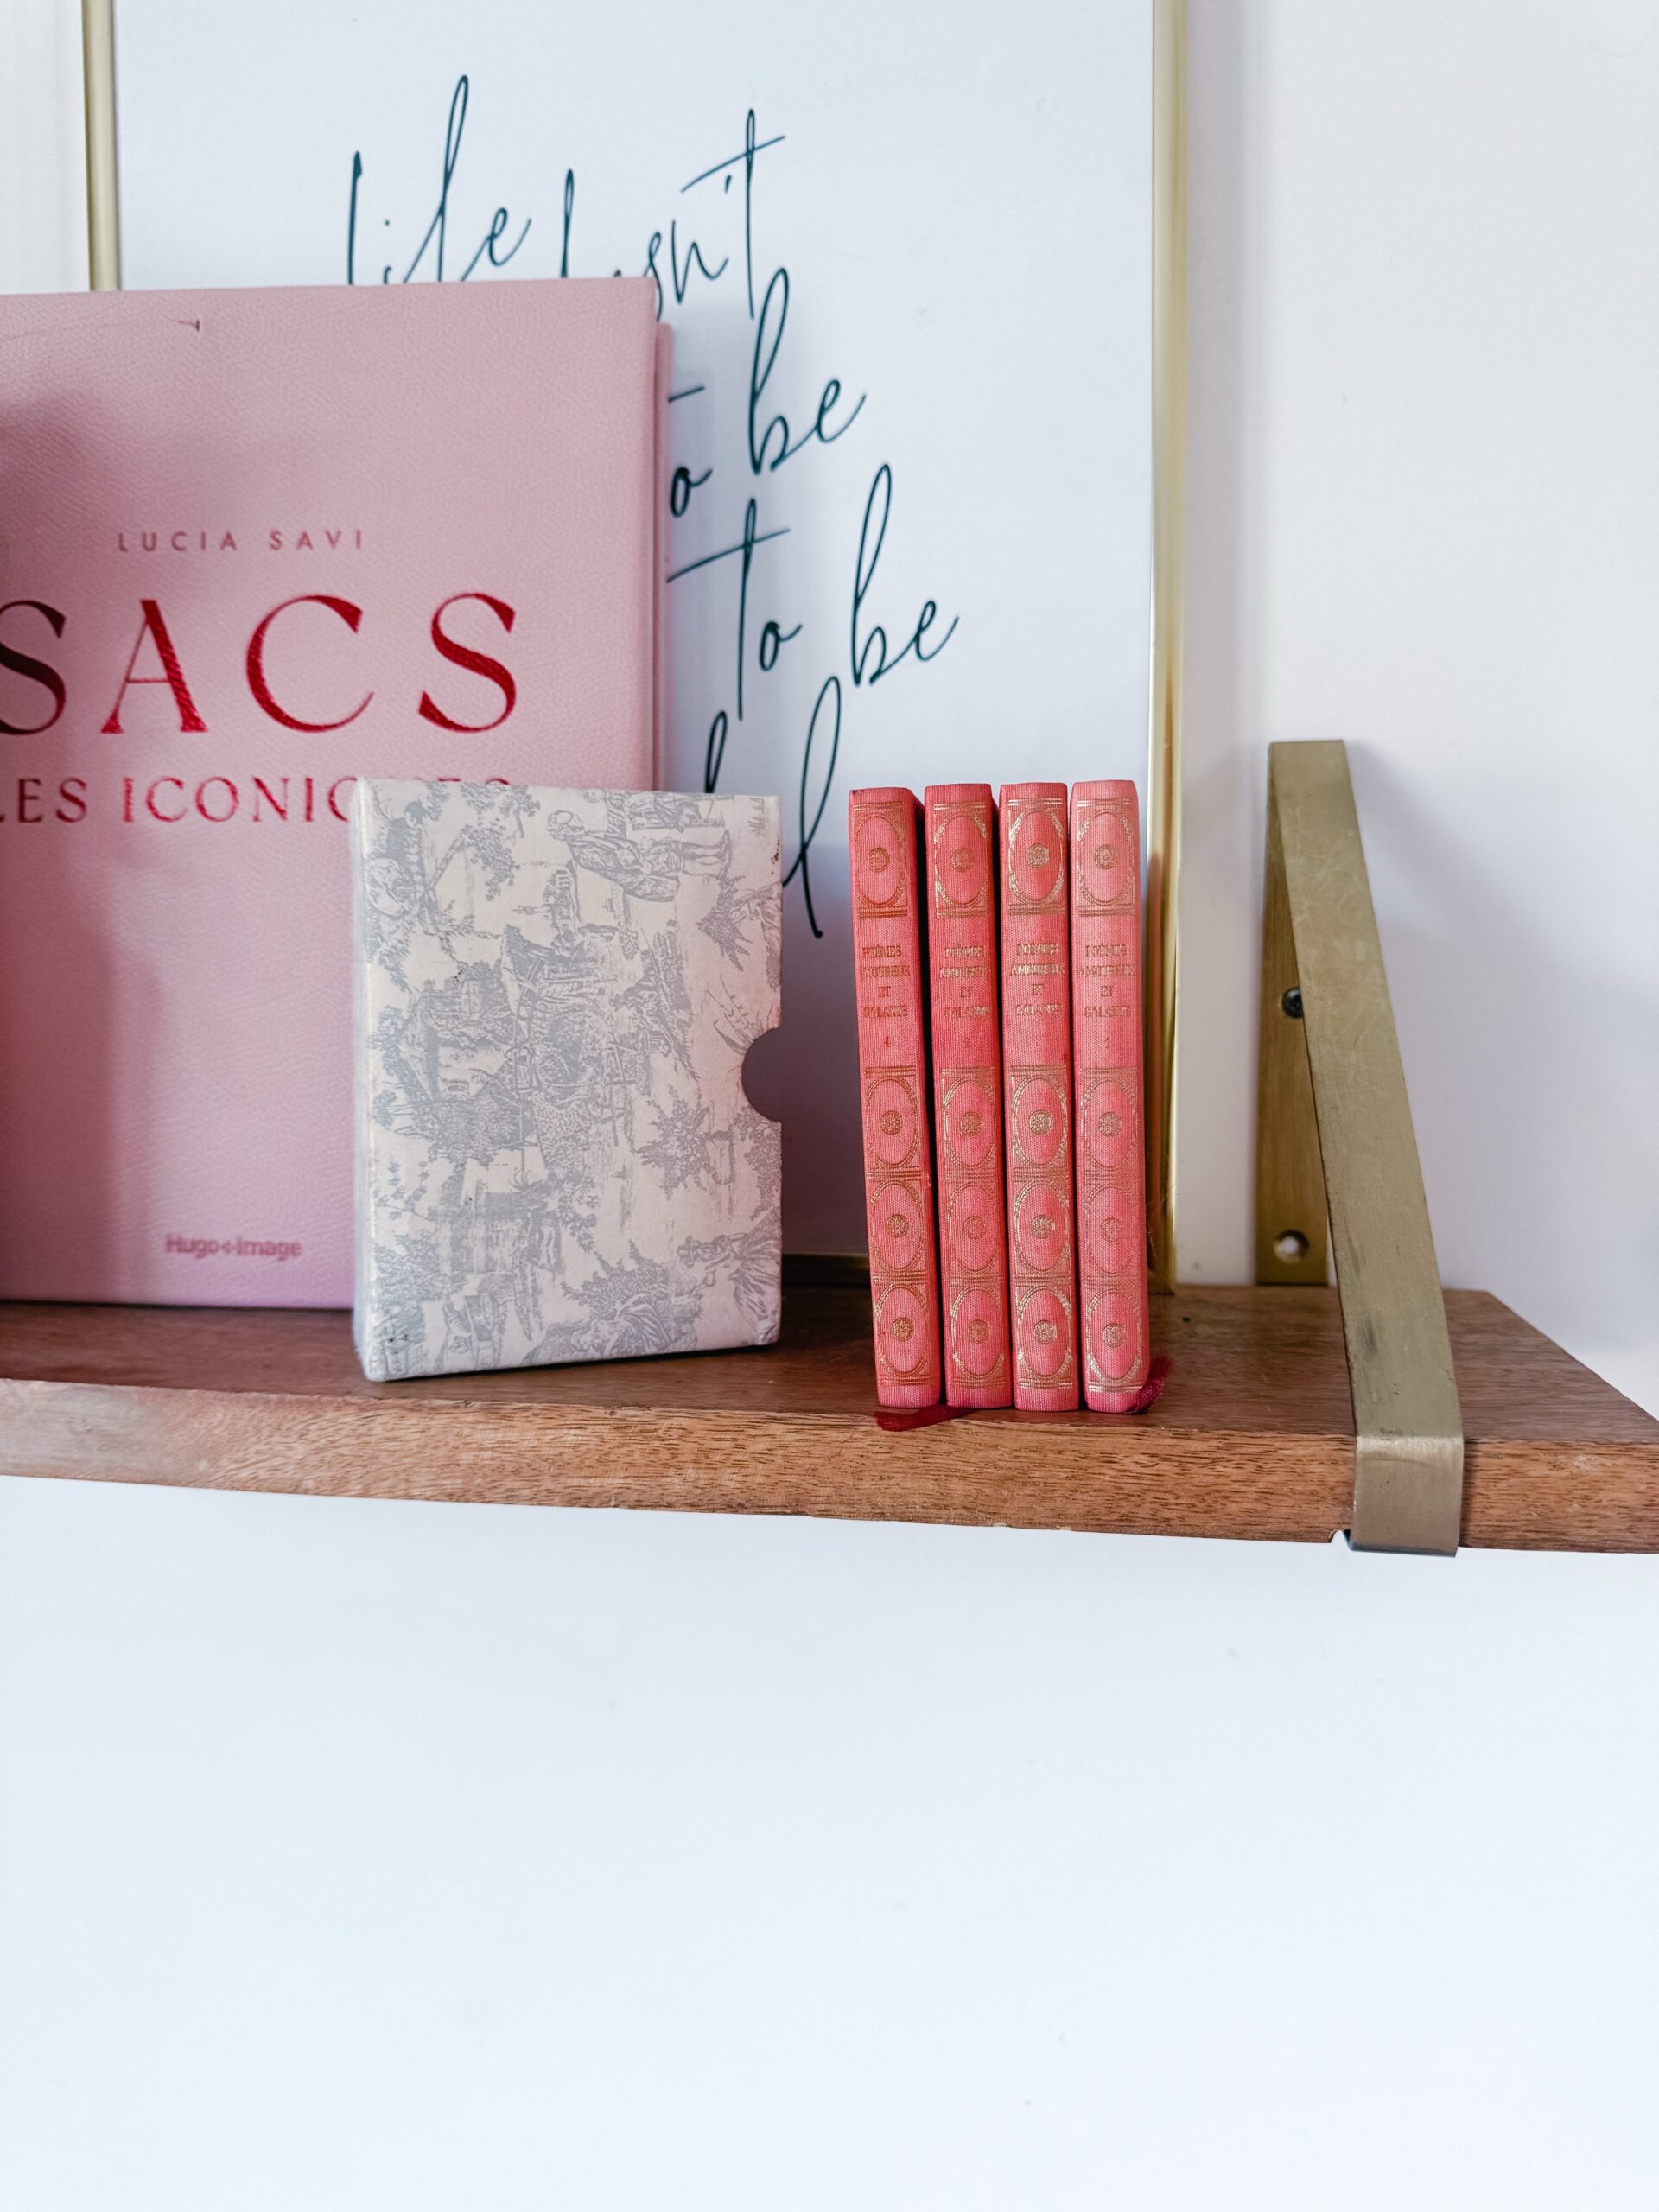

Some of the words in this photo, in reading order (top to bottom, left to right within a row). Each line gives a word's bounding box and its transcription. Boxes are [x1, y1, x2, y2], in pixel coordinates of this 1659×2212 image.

[749, 268, 867, 475] be
[117, 531, 238, 553] LUCIA
[269, 530, 362, 551] SAVI
[666, 498, 803, 721] to
[851, 464, 959, 687] be
[0, 592, 518, 735] SACS
[0, 777, 86, 823] ES
[860, 965, 911, 978] OUREUX
[878, 986, 891, 998] ET
